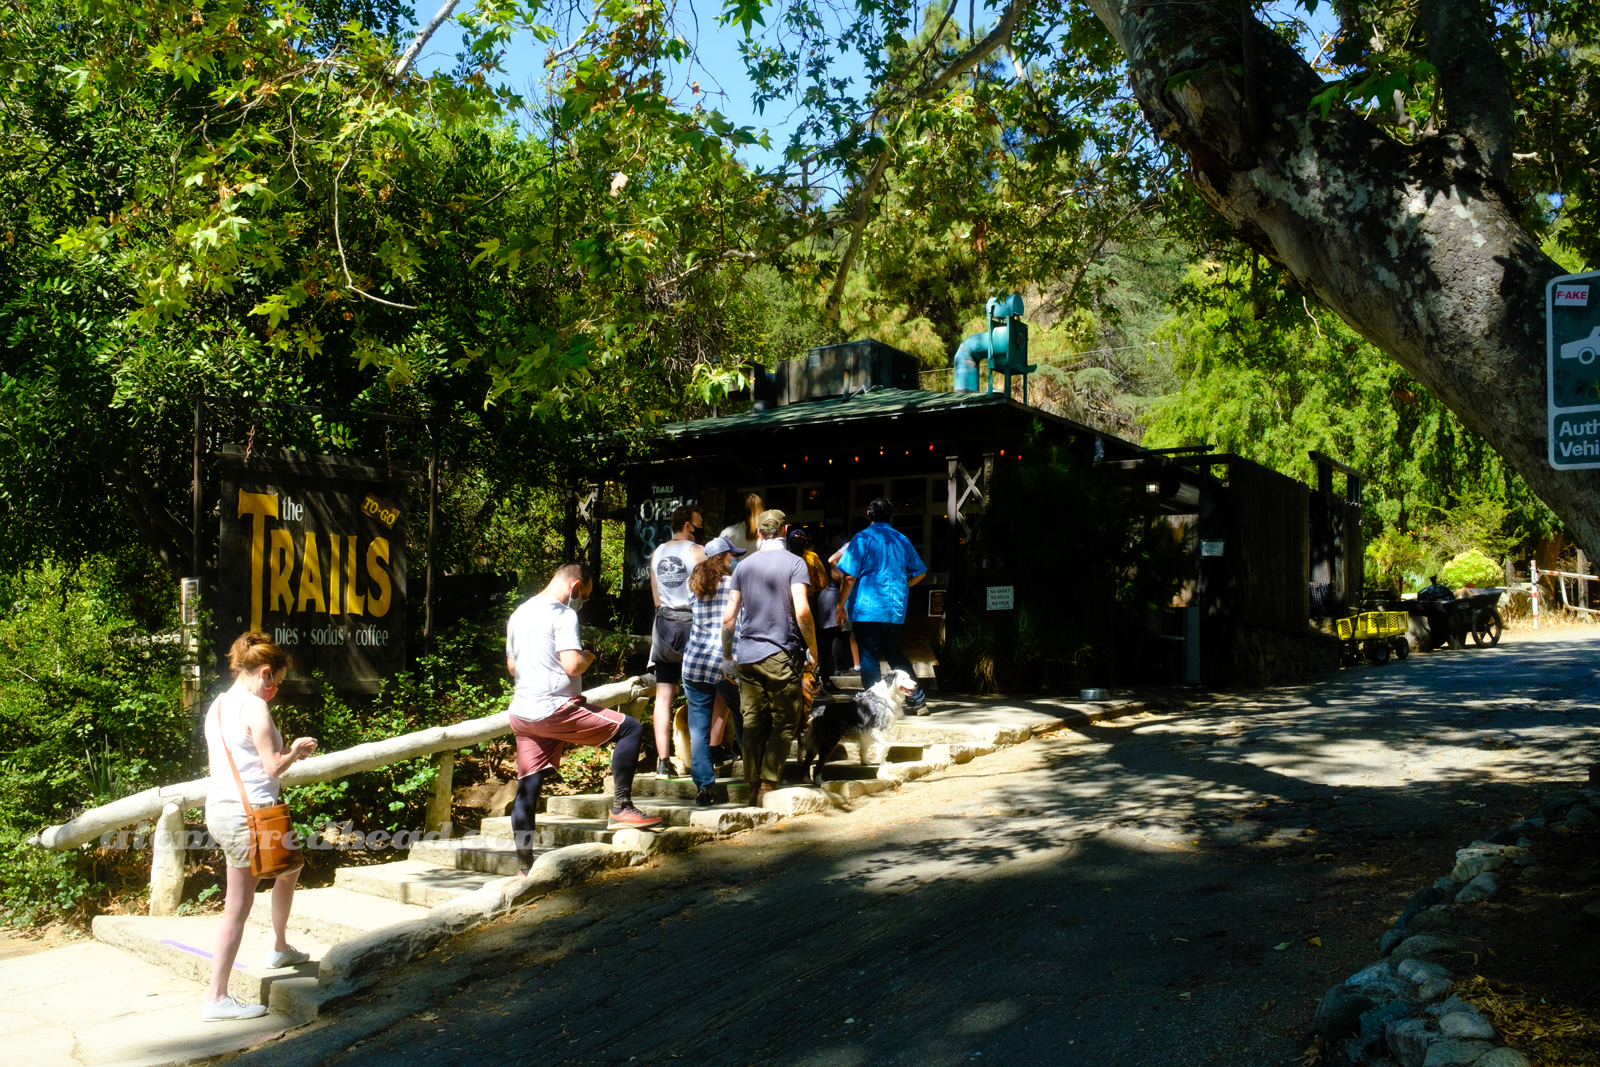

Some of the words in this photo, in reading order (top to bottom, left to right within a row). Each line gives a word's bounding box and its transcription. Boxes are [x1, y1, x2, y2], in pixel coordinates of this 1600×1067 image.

[652, 485, 674, 495] TRAILS
[282, 496, 303, 522] the
[363, 496, 396, 525] TO-GO
[238, 488, 392, 633] TRAILS
[275, 622, 299, 646] pies
[310, 623, 345, 646] sodas
[355, 624, 389, 647] coffee
